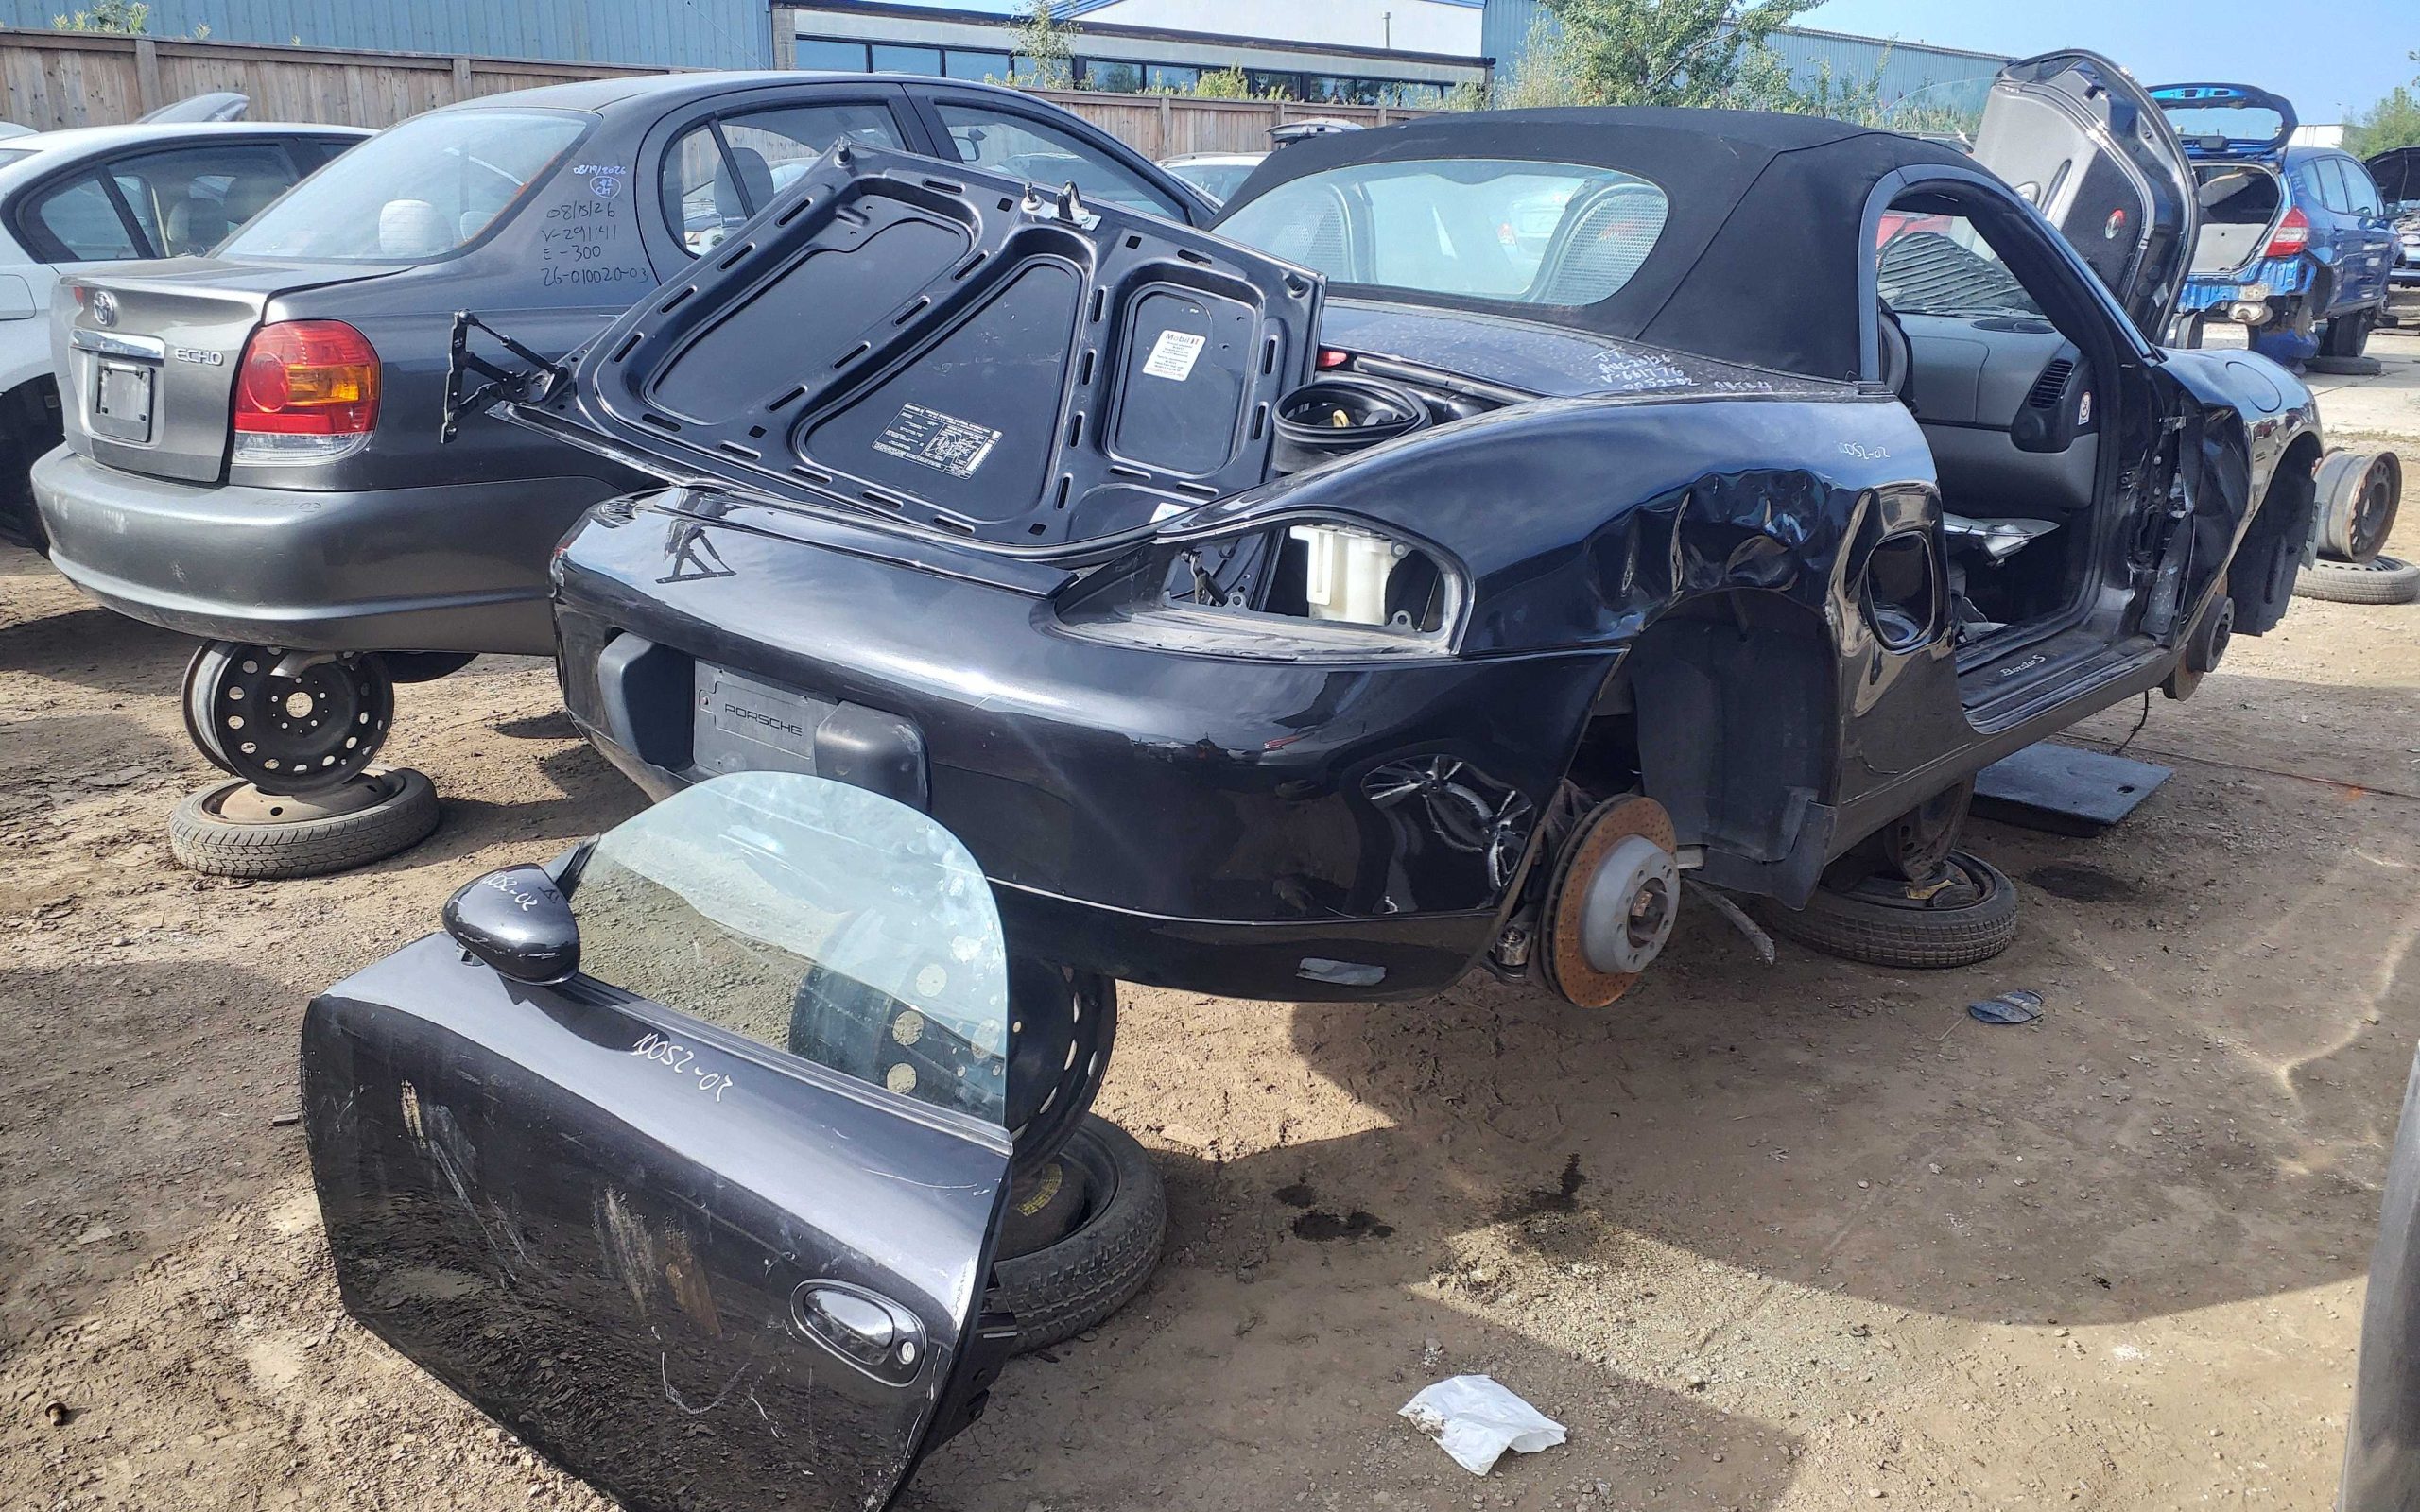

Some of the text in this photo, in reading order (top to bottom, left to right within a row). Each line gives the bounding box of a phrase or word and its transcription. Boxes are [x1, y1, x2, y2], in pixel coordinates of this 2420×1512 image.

[541, 266, 649, 287] 26-010020-03
[174, 348, 224, 367] ECHO
[2032, 654, 2046, 663] S
[724, 703, 803, 737] PORSCHE
